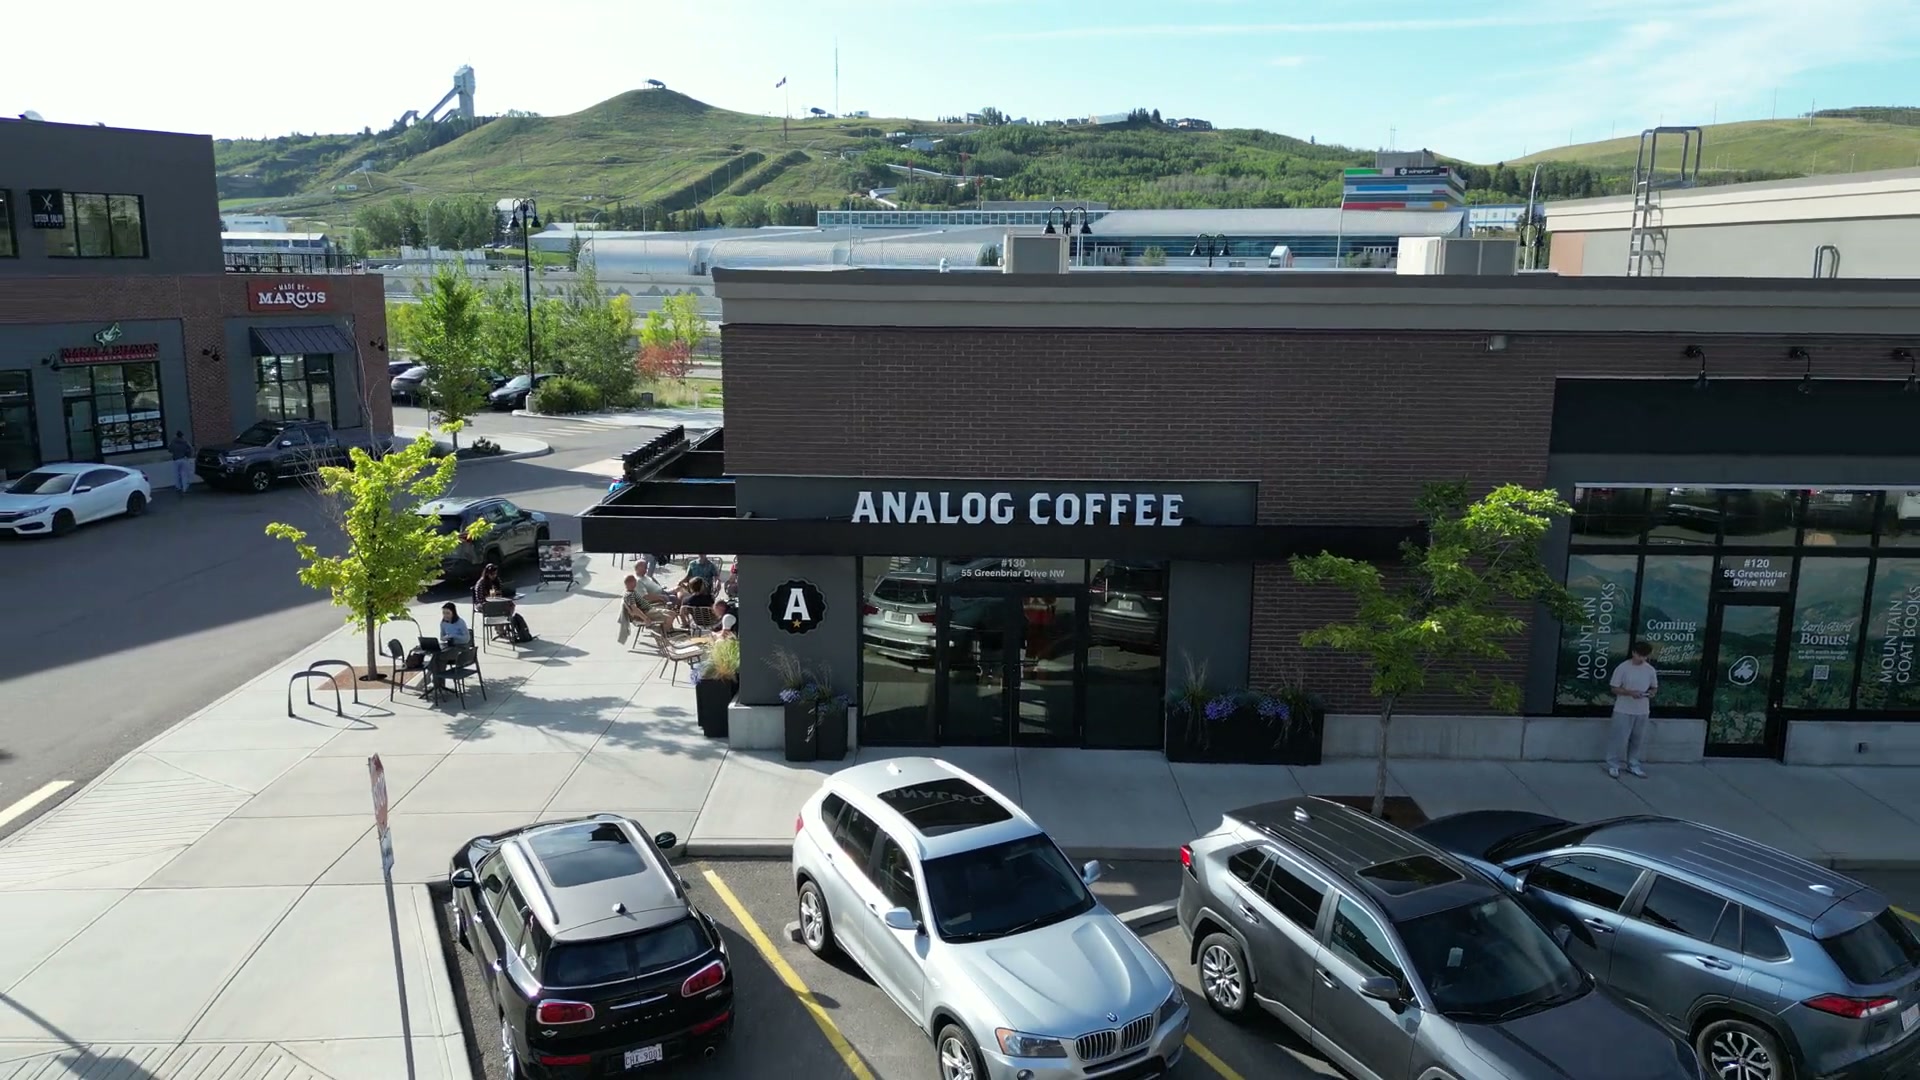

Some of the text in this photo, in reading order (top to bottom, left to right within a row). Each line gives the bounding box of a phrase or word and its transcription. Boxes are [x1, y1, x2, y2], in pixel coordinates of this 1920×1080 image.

[278, 283, 295, 291] MADE
[258, 291, 327, 309] MARCUS
[851, 491, 1184, 526] ANALOG COFFEE
[1001, 559, 1026, 568] #130
[1743, 558, 1770, 568] #120
[961, 569, 1065, 578] 55 Greenbriar Drive NW
[1723, 569, 1787, 578] 55 Greenbriar
[1732, 578, 1776, 587] Drive NW
[783, 588, 811, 620] A
[1593, 583, 1616, 679] GOAT BOOKS
[1647, 619, 1697, 633] Coming
[1801, 621, 1855, 634] Early Bird
[1646, 632, 1695, 641] so soon
[1800, 633, 1850, 645] Bonus!
[1896, 586, 1920, 683] GOAT BOOKS
[1879, 600, 1902, 682] MOUNTAIN
